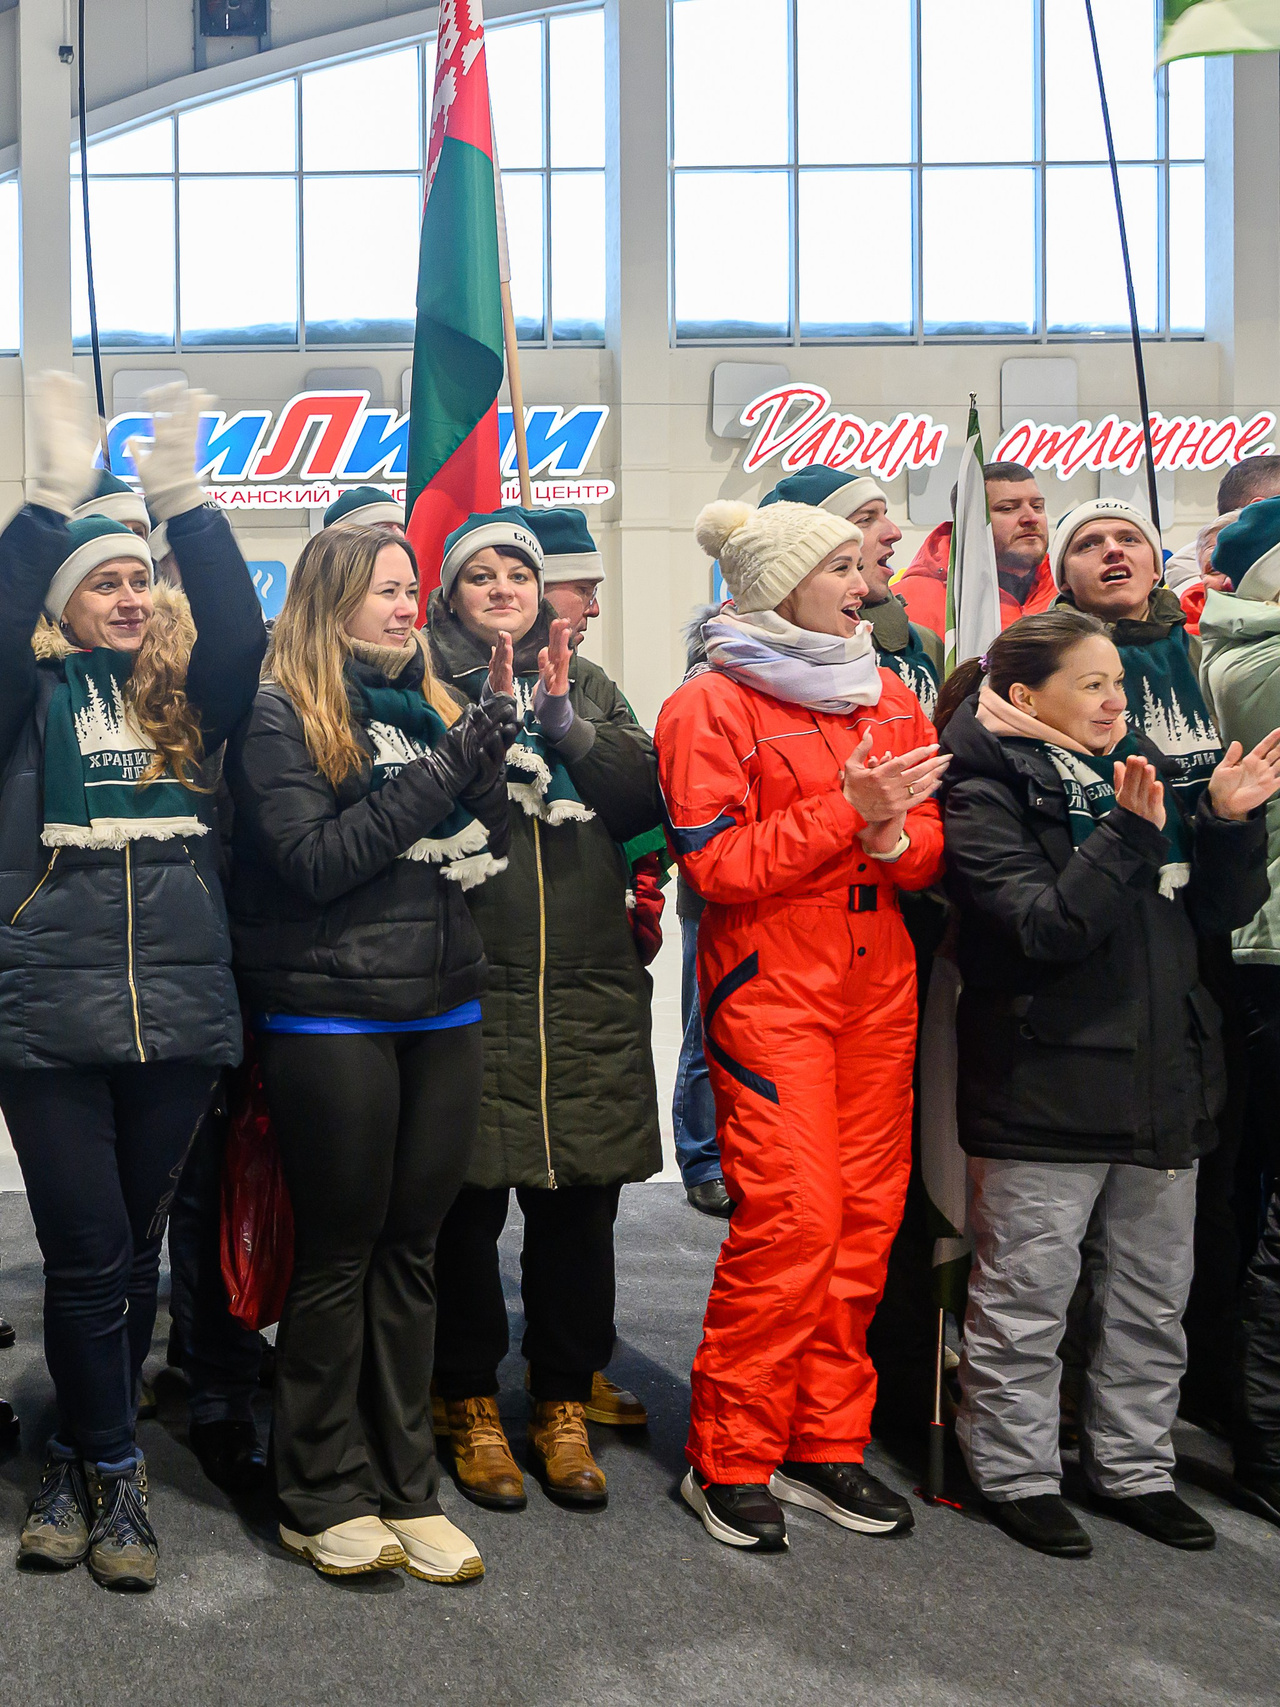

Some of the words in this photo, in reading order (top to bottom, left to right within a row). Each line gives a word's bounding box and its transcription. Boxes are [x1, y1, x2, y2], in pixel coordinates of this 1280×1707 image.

[745, 388, 943, 478] Дарим
[996, 415, 1271, 476] отличное
[207, 485, 330, 505] КАНСКИЙ
[535, 485, 609, 502] ЦЕНТР
[88, 751, 160, 769] ХРАНИТ
